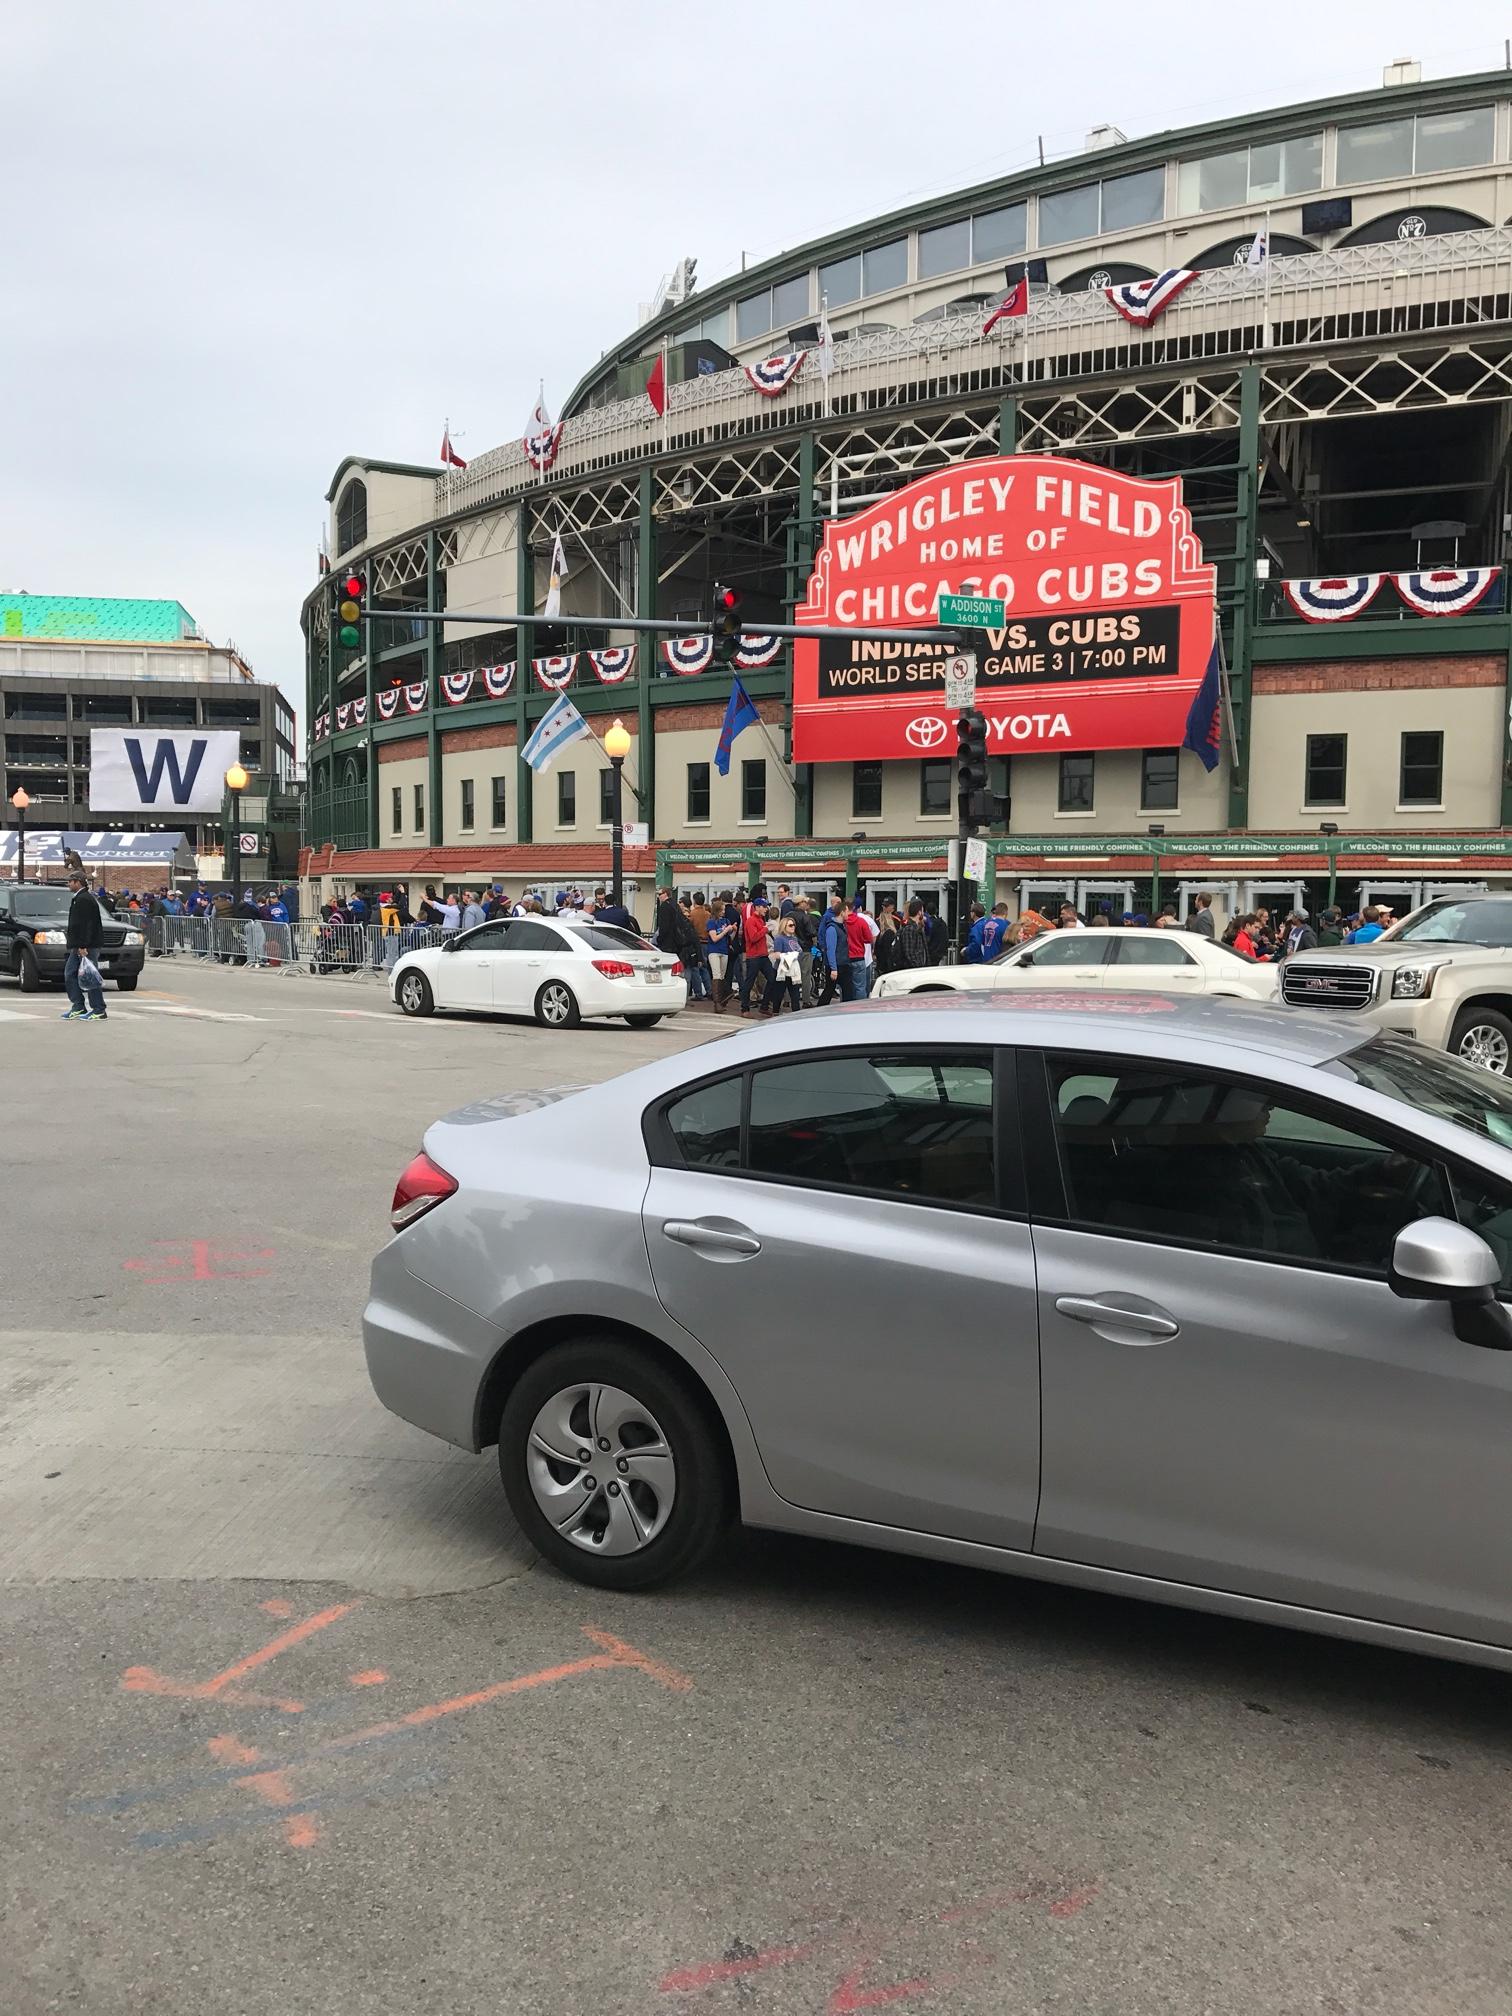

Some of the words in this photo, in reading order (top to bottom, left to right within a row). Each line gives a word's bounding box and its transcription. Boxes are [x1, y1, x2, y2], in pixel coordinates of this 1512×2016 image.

[836, 475, 1015, 572] WRIGLEY
[1036, 475, 1162, 538] FIELD
[920, 533, 1004, 564] HOME
[1026, 527, 1068, 552] OF
[1037, 559, 1162, 604] CUBS
[942, 600, 947, 608] W
[950, 599, 992, 613] ADDISON
[994, 605, 1002, 613] ST
[956, 613, 979, 623] 3600
[982, 616, 988, 624] N
[985, 624, 1037, 651] VS.
[1048, 615, 1141, 646] CUBS
[829, 665, 900, 687] WORLD
[984, 654, 1045, 675] GAME
[1052, 653, 1063, 671] 3
[1082, 648, 1126, 669] 7:00
[1133, 645, 1166, 665] PM
[952, 713, 1072, 742] YOTA
[123, 738, 208, 805] W
[86, 831, 151, 847] IT
[1305, 978, 1339, 990] GMC
